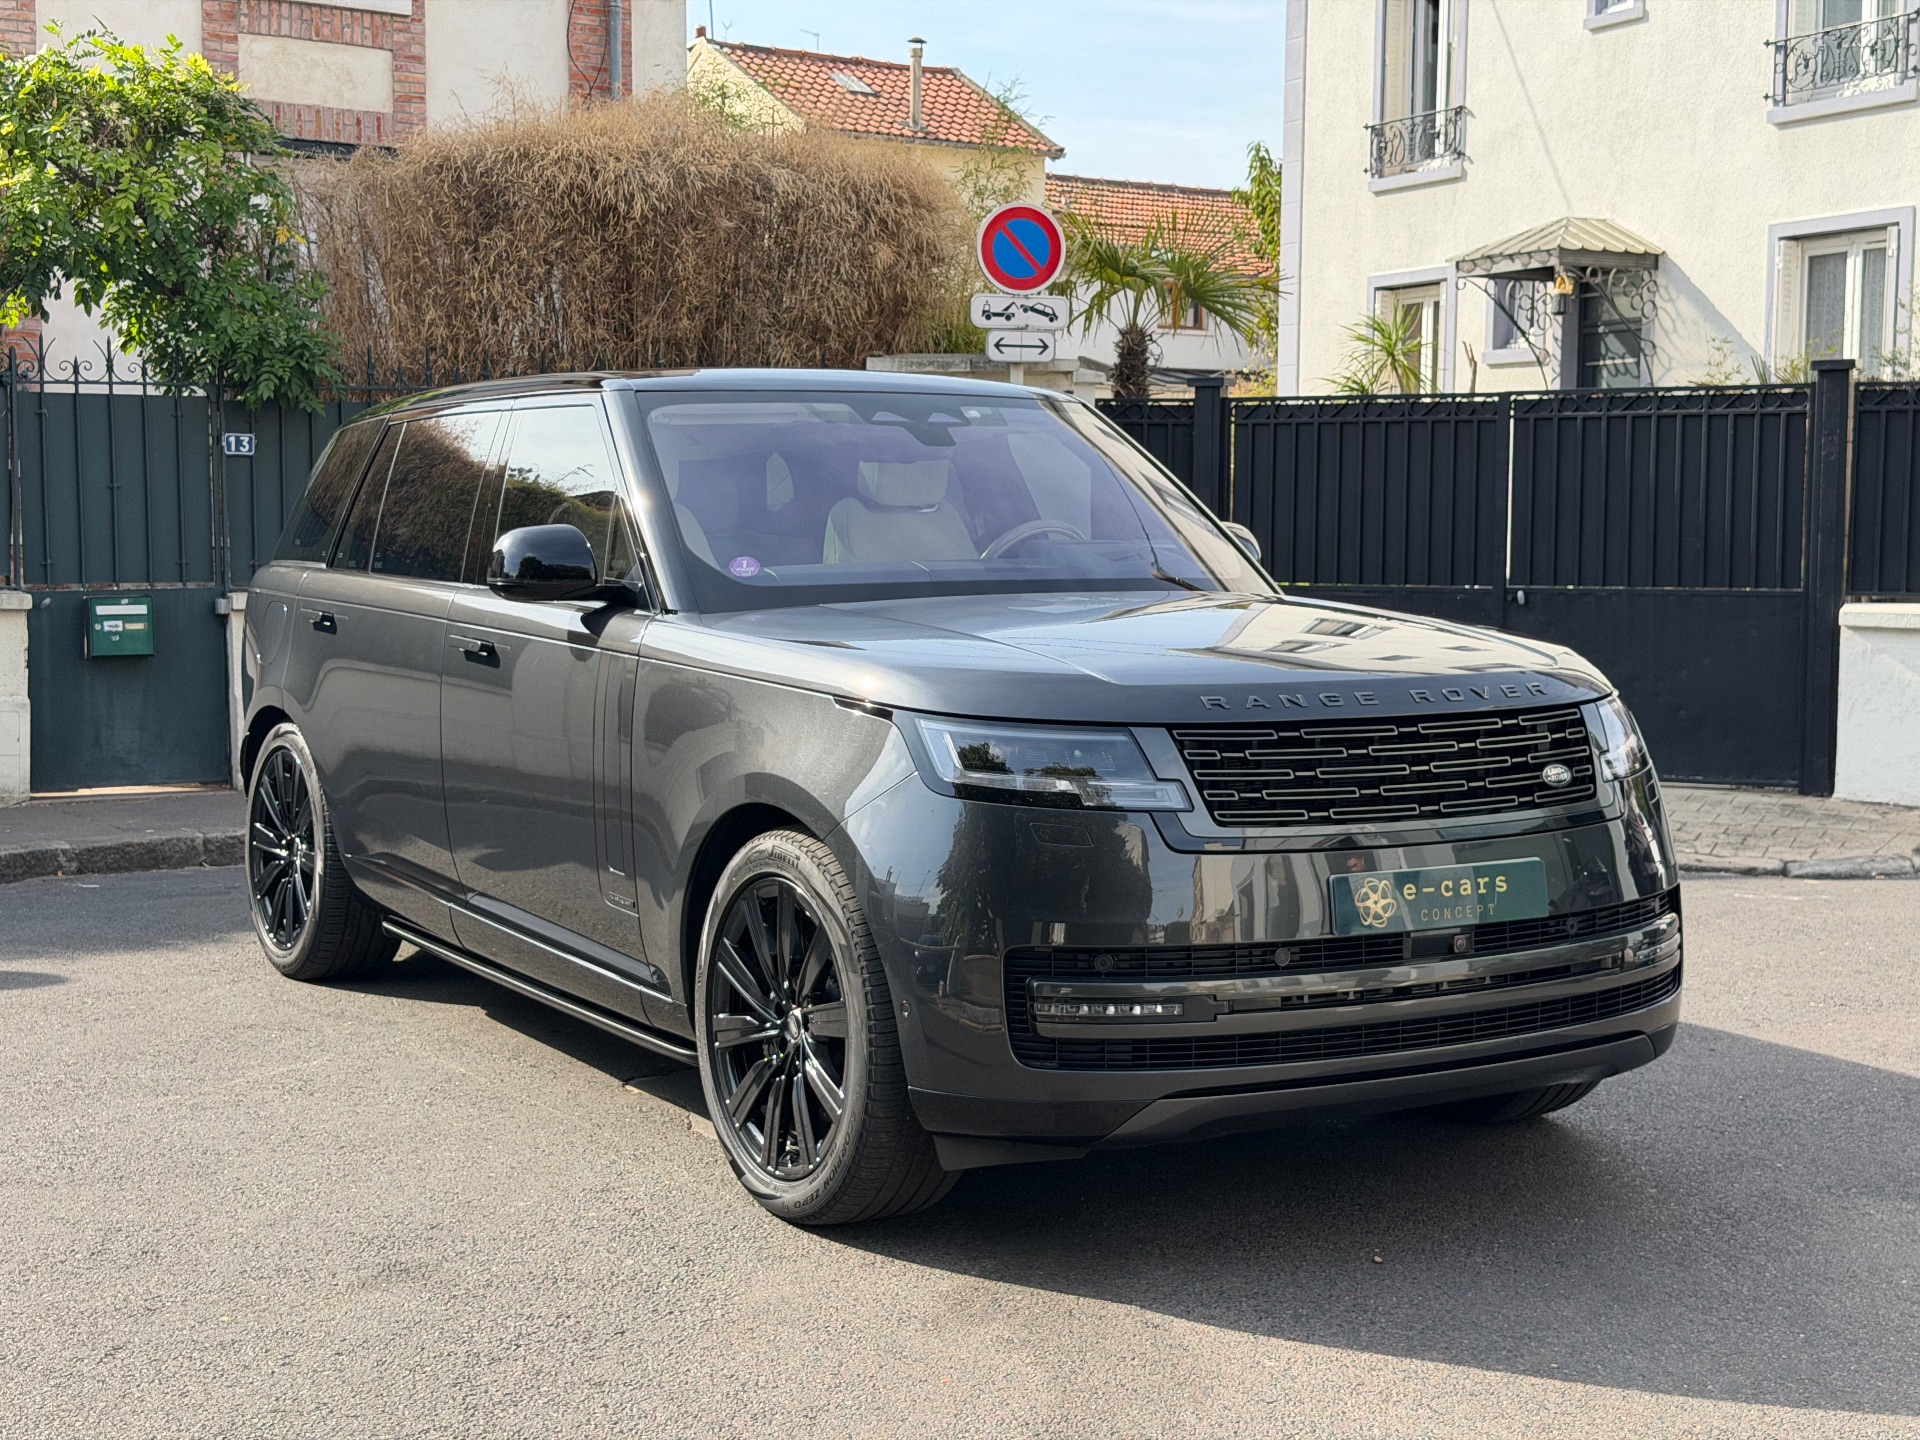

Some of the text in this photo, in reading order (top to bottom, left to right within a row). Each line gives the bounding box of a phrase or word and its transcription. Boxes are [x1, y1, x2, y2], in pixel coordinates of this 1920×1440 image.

[229, 435, 250, 452] 13
[1200, 682, 1548, 710] RANGE ROVER
[770, 844, 801, 870] PIRELLI
[1403, 875, 1508, 901] e-cars
[1421, 903, 1495, 922] CONCEPT
[823, 1109, 857, 1190] SCORPION
[794, 1189, 820, 1209] ZERO
